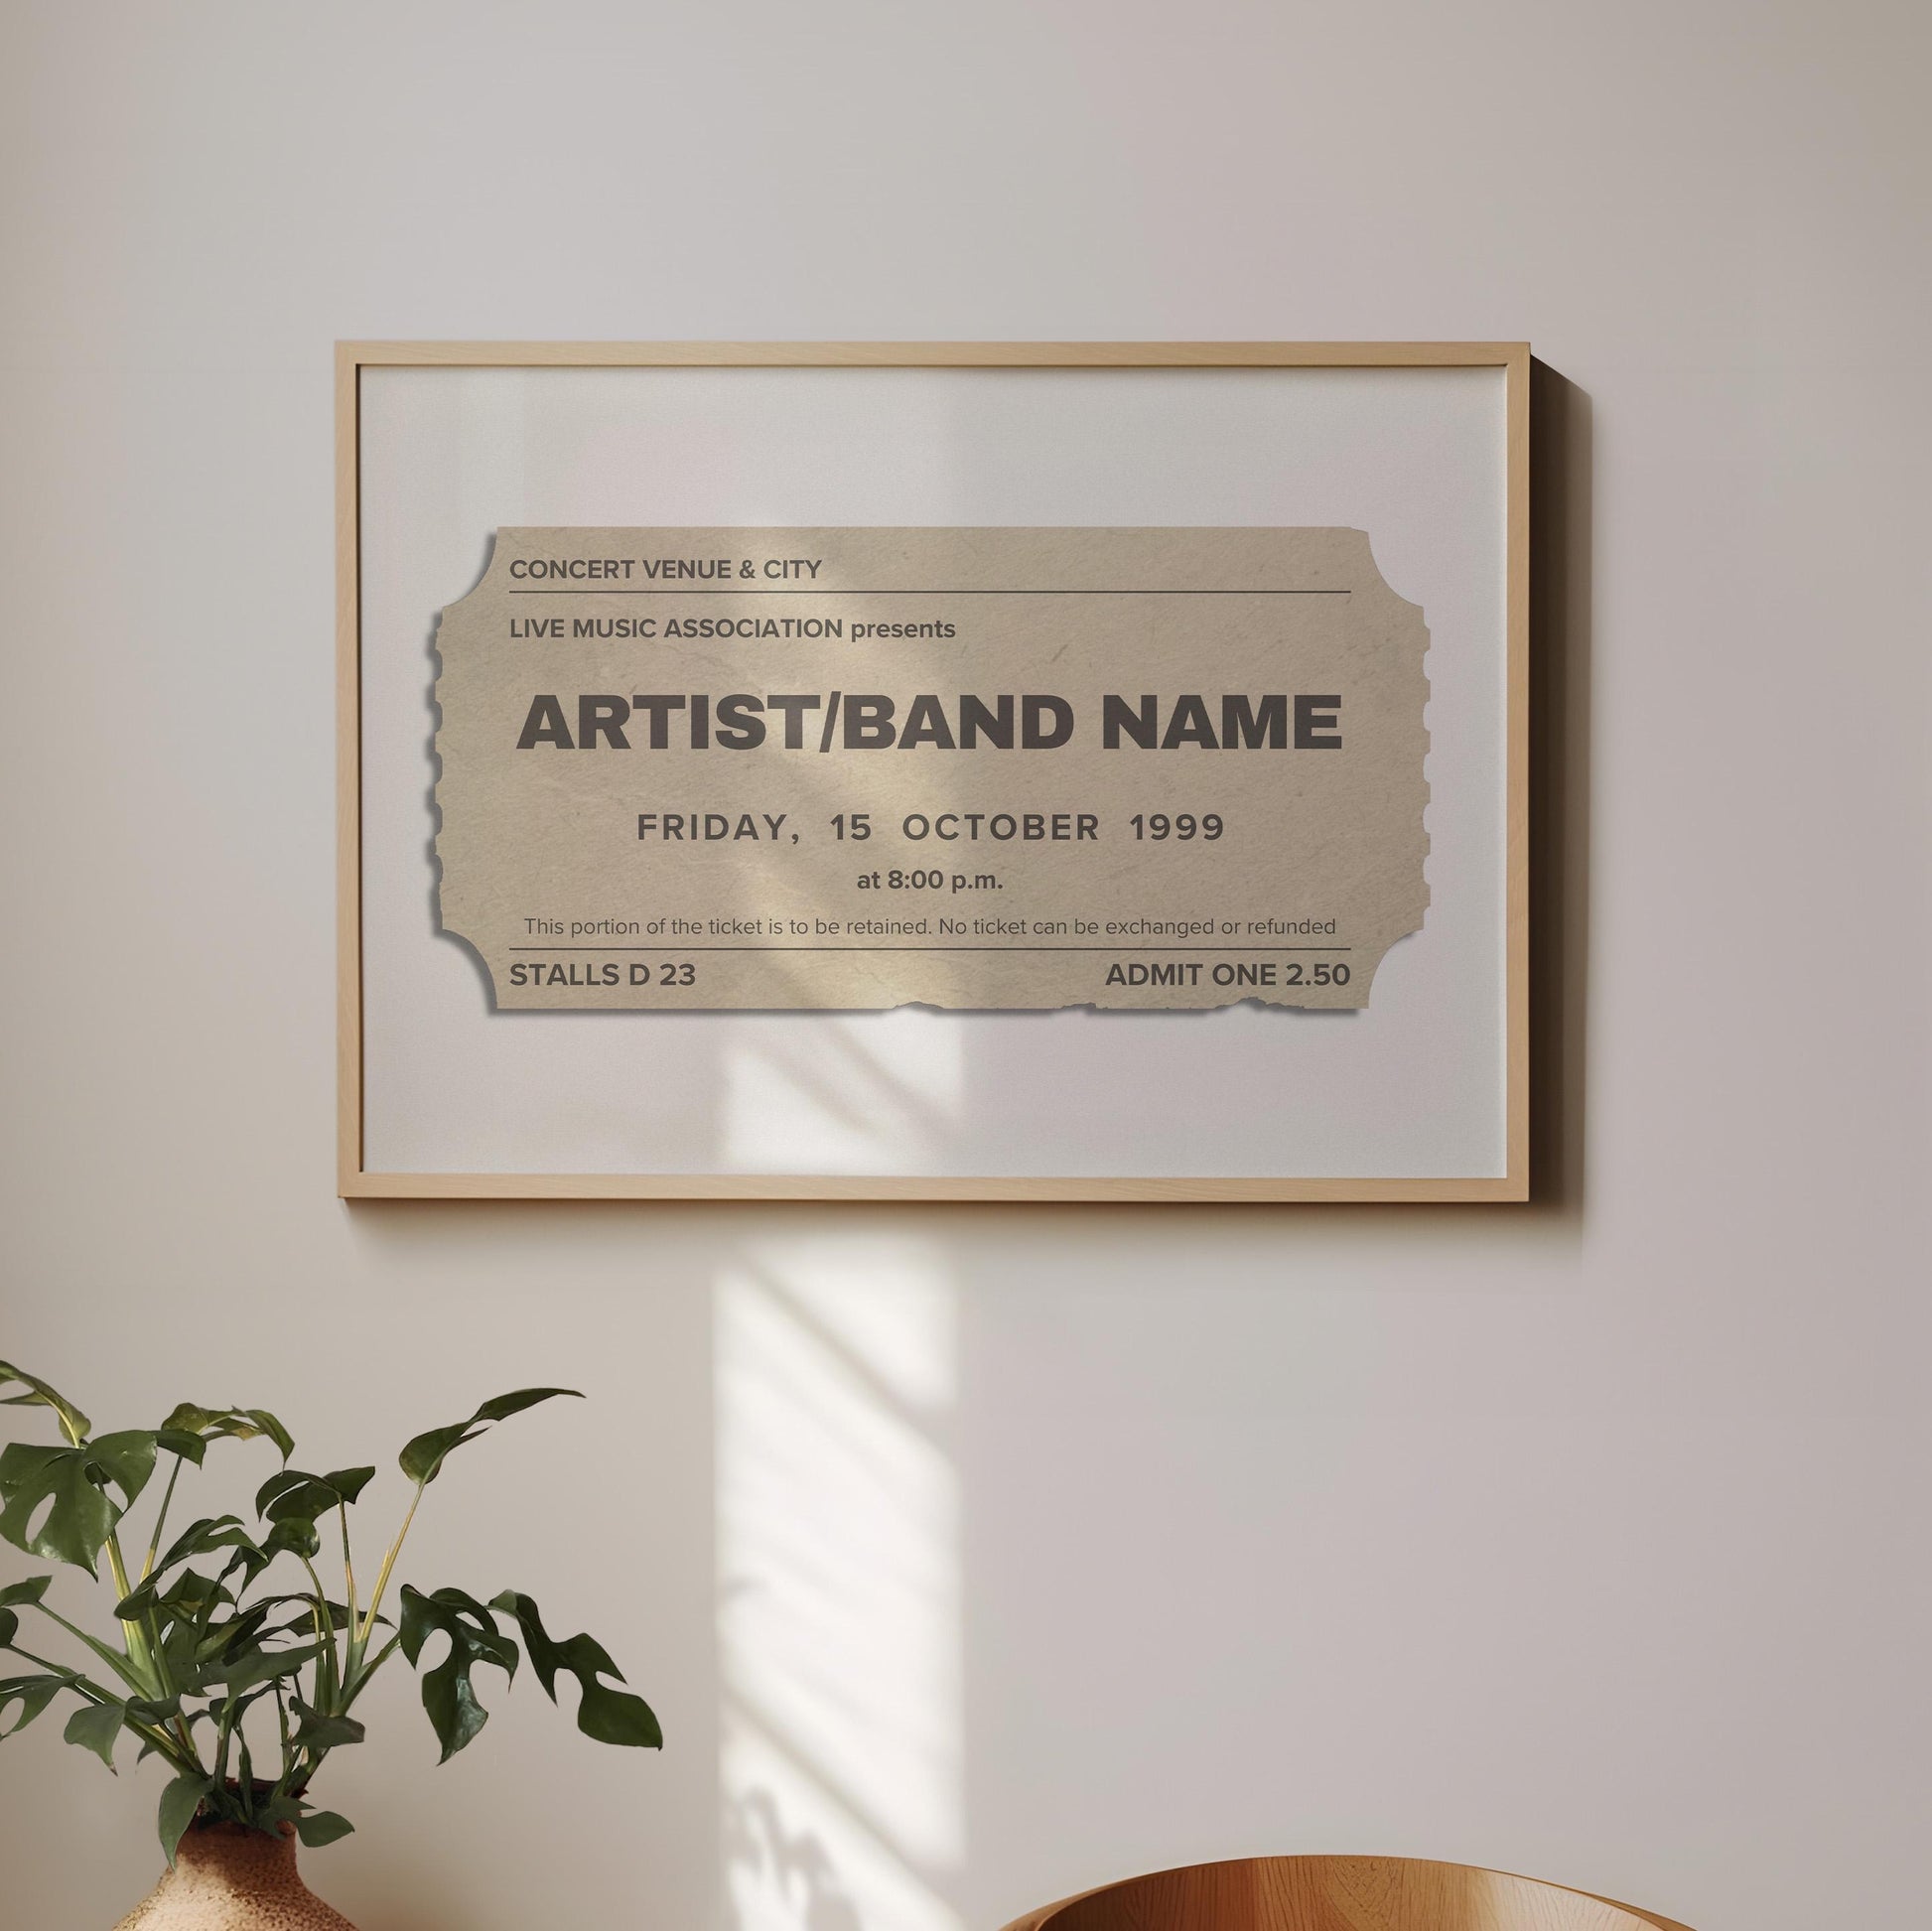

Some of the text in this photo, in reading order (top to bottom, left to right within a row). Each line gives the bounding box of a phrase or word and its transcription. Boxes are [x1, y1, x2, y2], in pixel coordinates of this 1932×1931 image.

[509, 559, 823, 580] CONCERT VENUE & CITY
[510, 618, 956, 643] LIVE MUSIC ASSOCIATION presents
[515, 690, 1342, 754] ARTIST/BAND NAME
[637, 813, 1224, 846] FRIDAY, 15 OCTOBER 1999
[857, 869, 1004, 895] at 8:00 p.m.
[523, 917, 1336, 939] This portion of the ticket is to be retained. No ticket can be exchanged or refunded
[509, 963, 696, 987] STALLS D 23
[1104, 963, 1351, 987] ADMIT ONE 2.50
